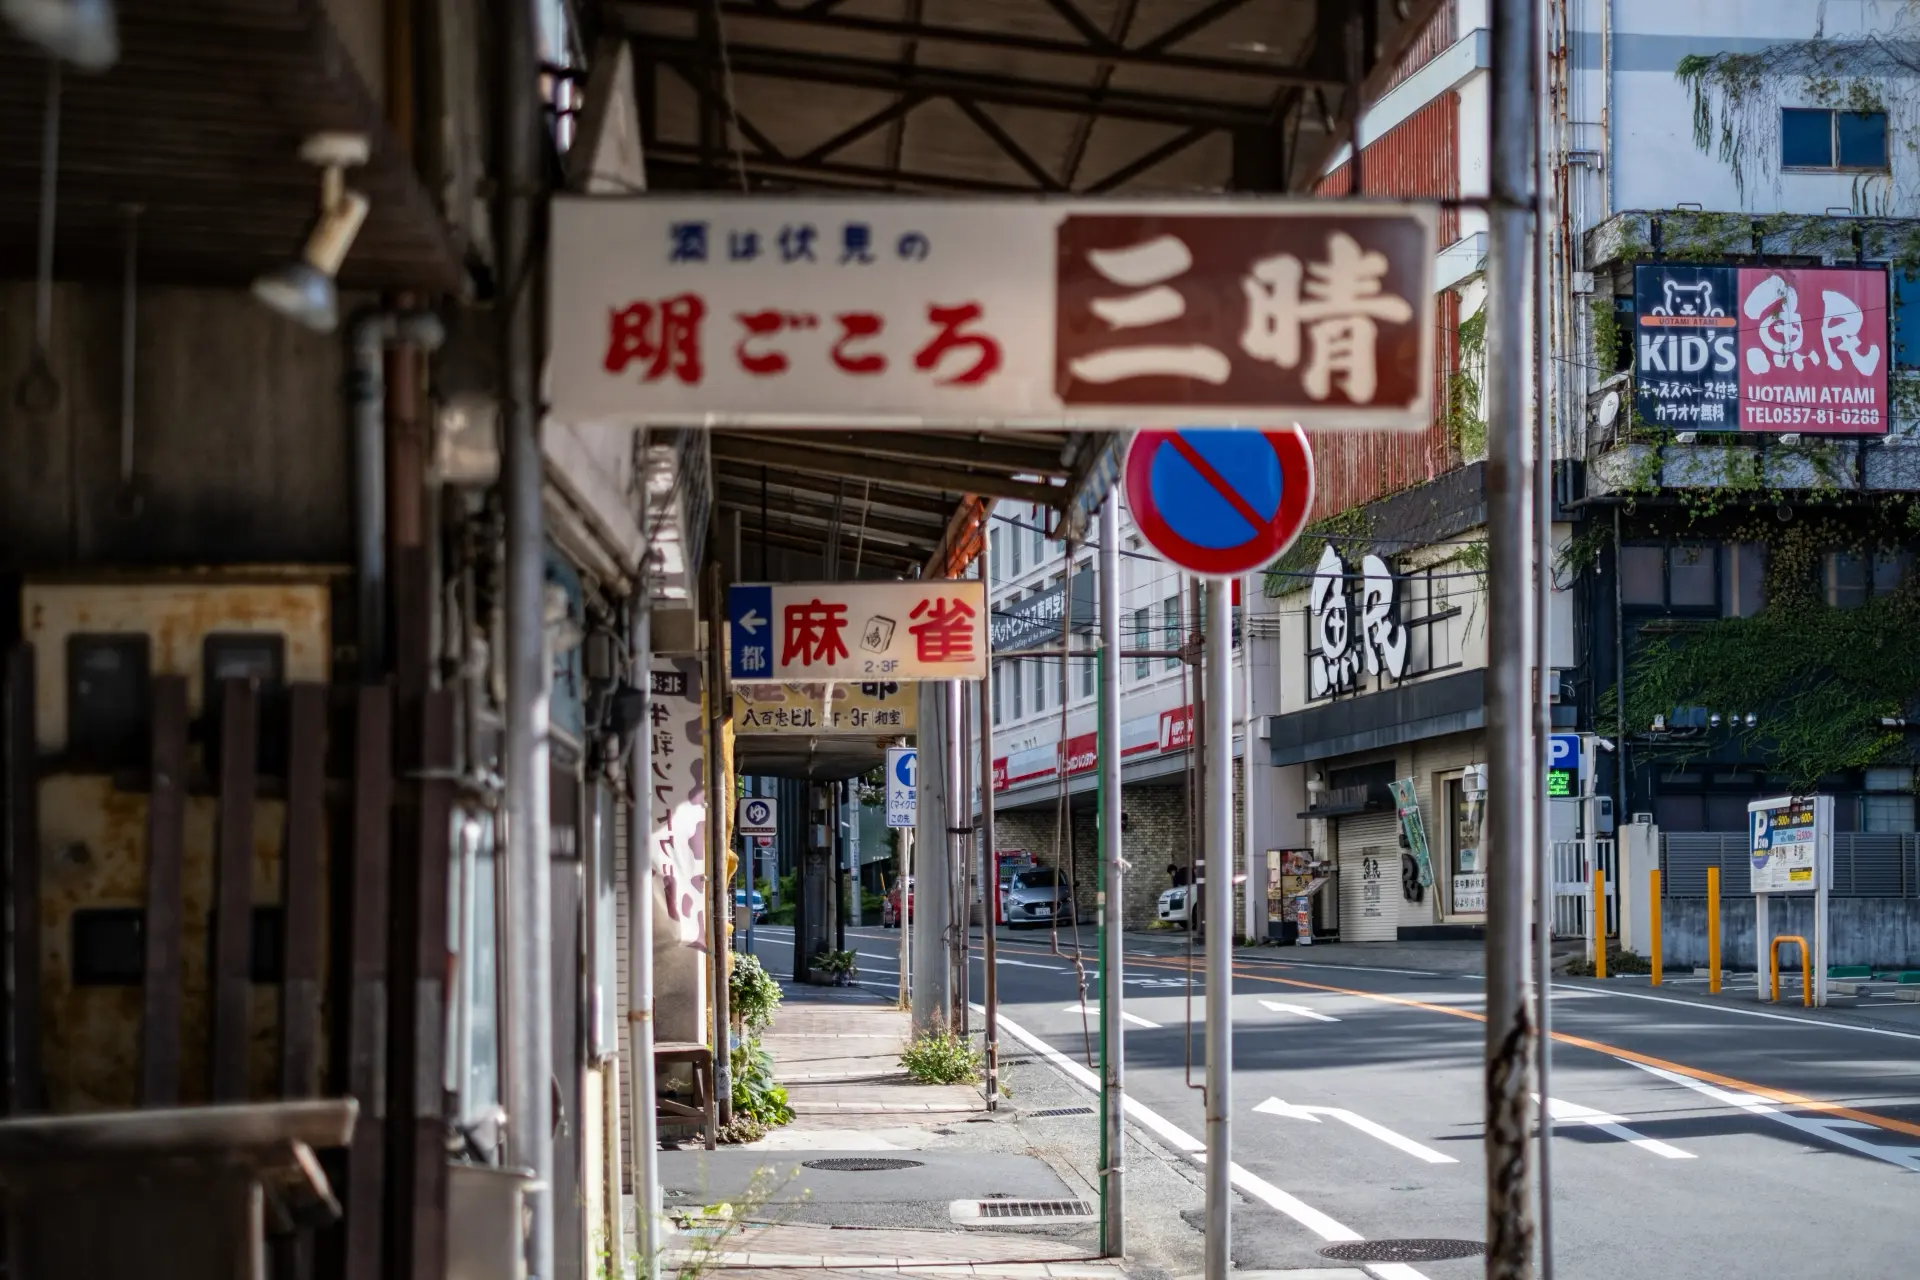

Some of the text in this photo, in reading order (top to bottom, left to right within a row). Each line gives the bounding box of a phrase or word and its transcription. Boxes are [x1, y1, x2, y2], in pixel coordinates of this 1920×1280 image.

[669, 222, 931, 264] 酒は伏見の
[1659, 318, 1690, 326] UOTAMI
[1743, 275, 1881, 377] 魚民
[603, 293, 1003, 386] 明ごころ
[1640, 381, 1738, 400] キッズスペース付き
[1749, 386, 1875, 404] UOTAMI ATAMI
[1654, 404, 1725, 422] カラオケ無料
[781, 597, 976, 667] 麻雀
[1311, 544, 1407, 696] 魚民
[740, 645, 765, 672] 都
[742, 708, 816, 727] 八百忠ビル
[1548, 739, 1569, 767] P
[750, 804, 767, 822] ゆ
